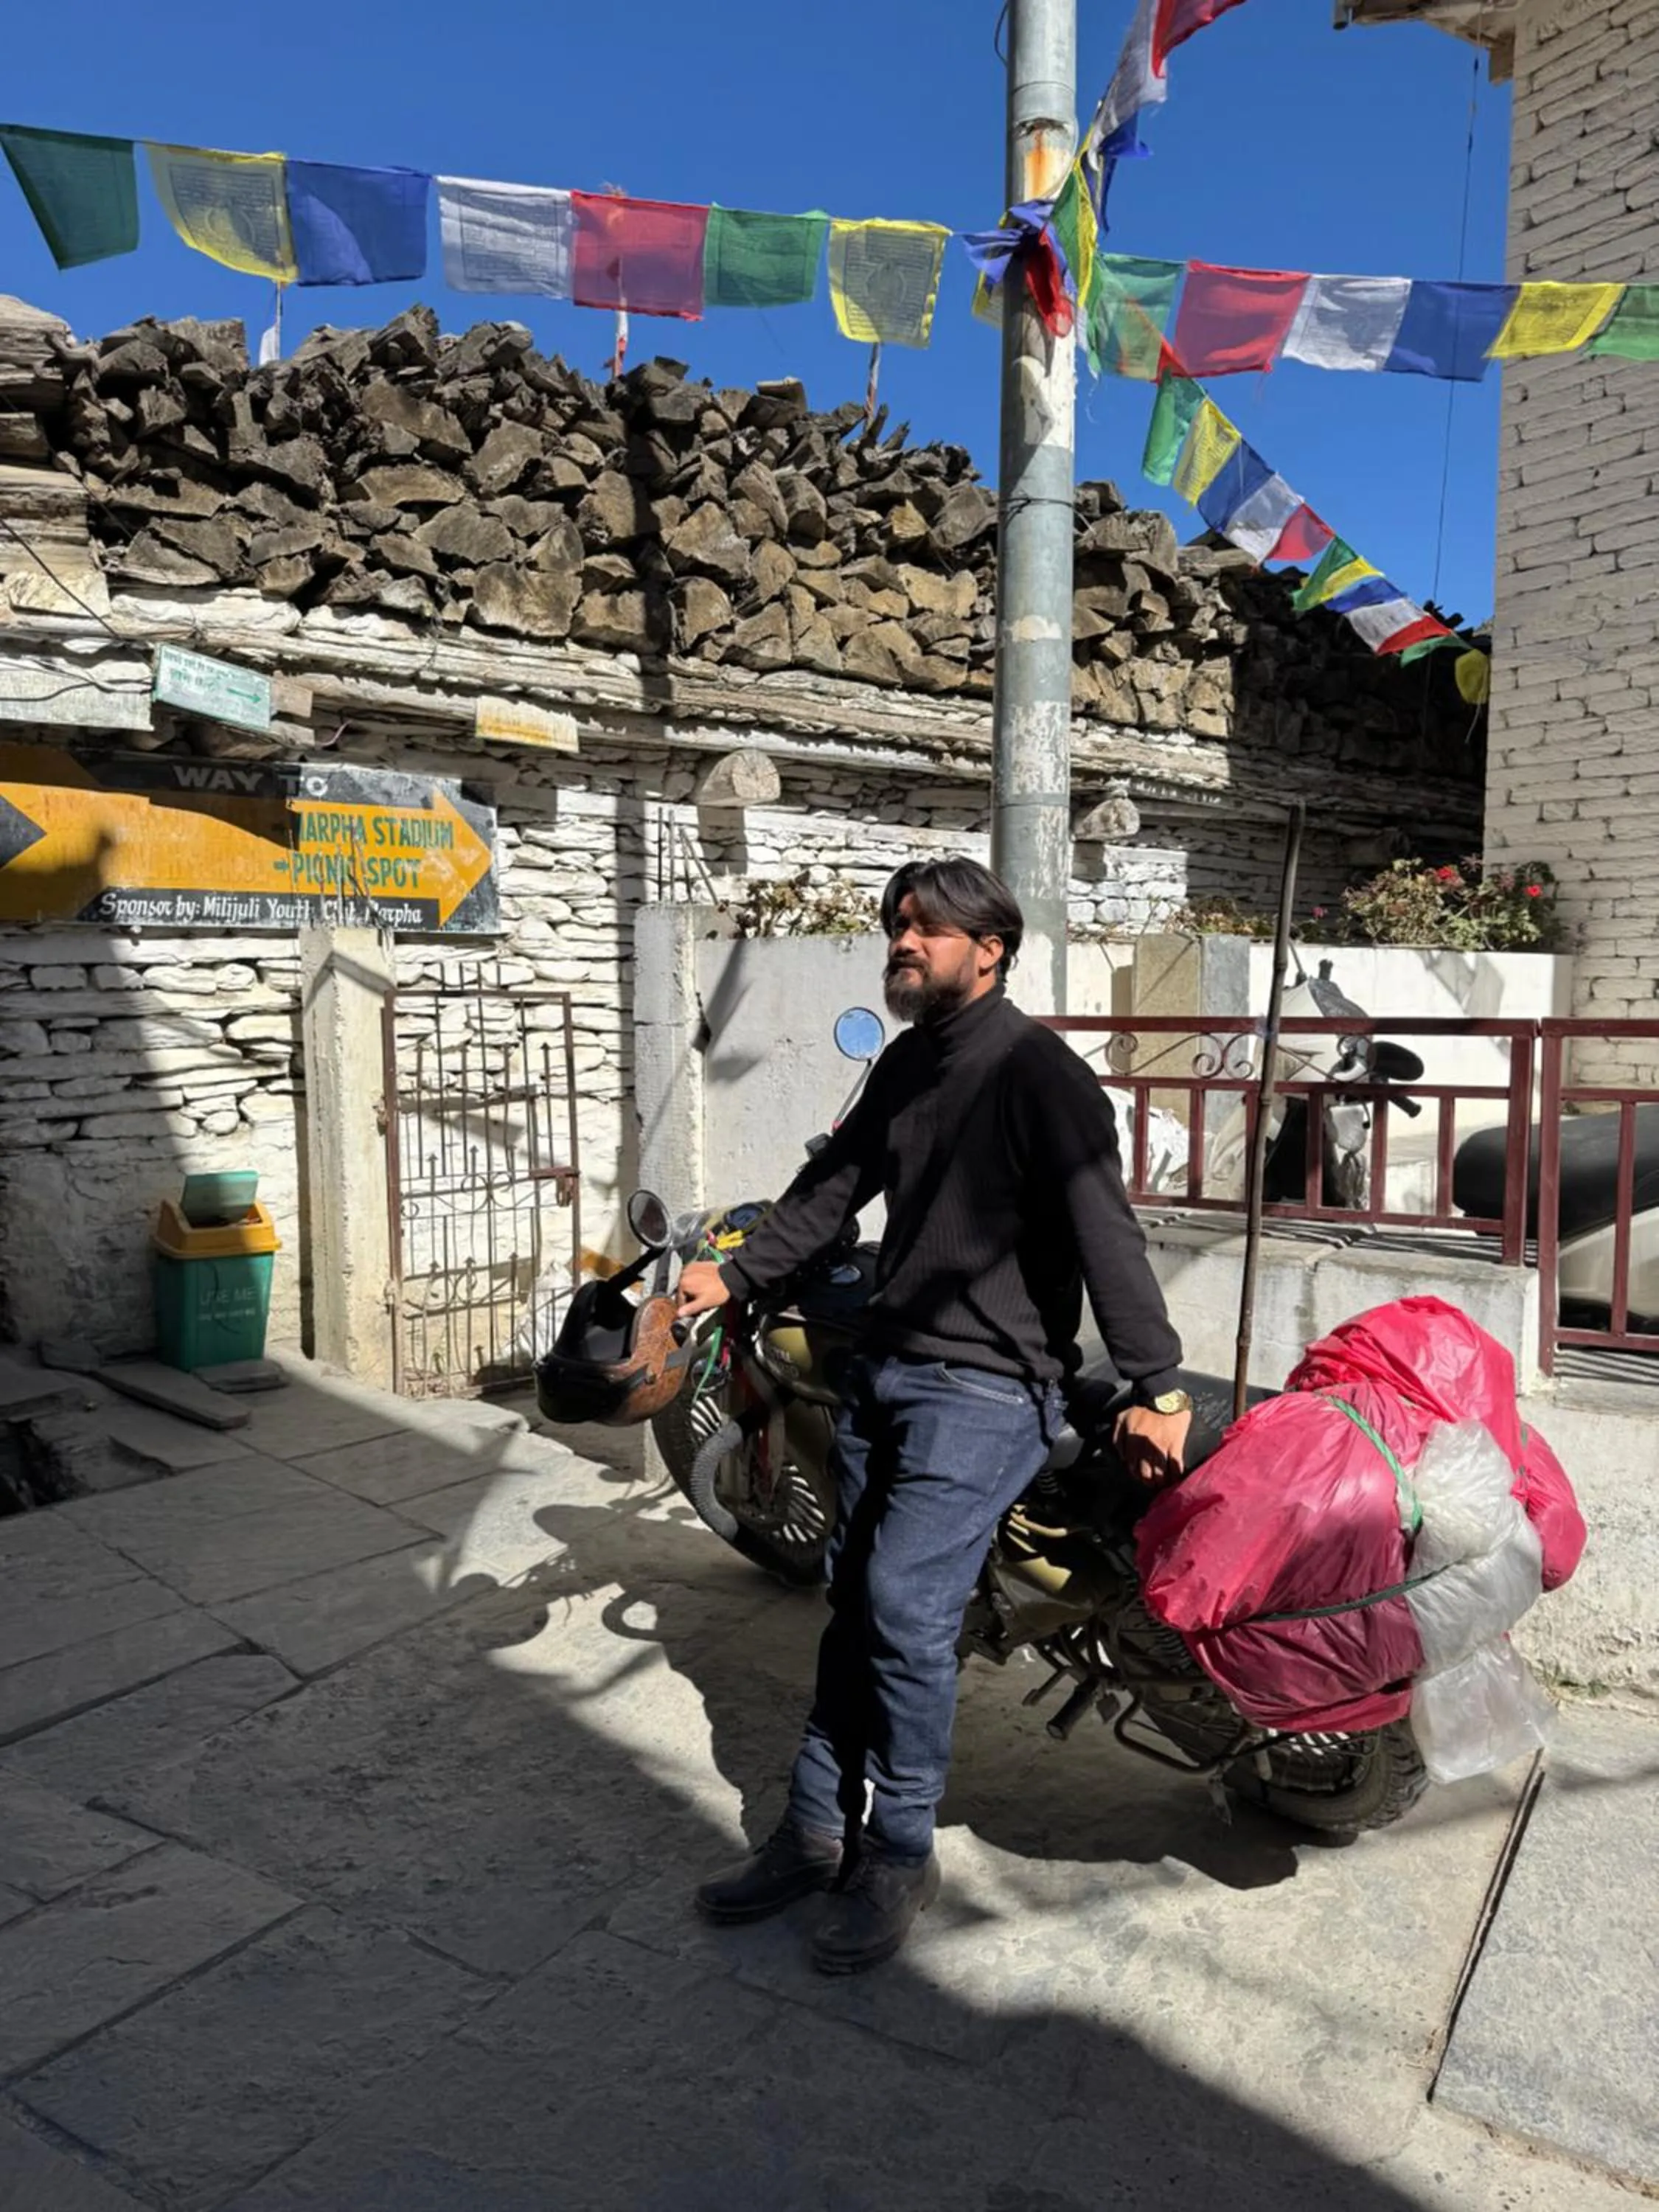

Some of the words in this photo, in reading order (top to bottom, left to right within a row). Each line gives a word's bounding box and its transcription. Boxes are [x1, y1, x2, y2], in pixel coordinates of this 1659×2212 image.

[173, 765, 264, 792] WAY
[276, 773, 329, 796] TO
[296, 812, 367, 844] ARPHA
[372, 816, 454, 849] STADIUM
[366, 855, 420, 888] SPOT
[99, 893, 174, 921] Sponsor
[203, 895, 260, 922] Milijuli
